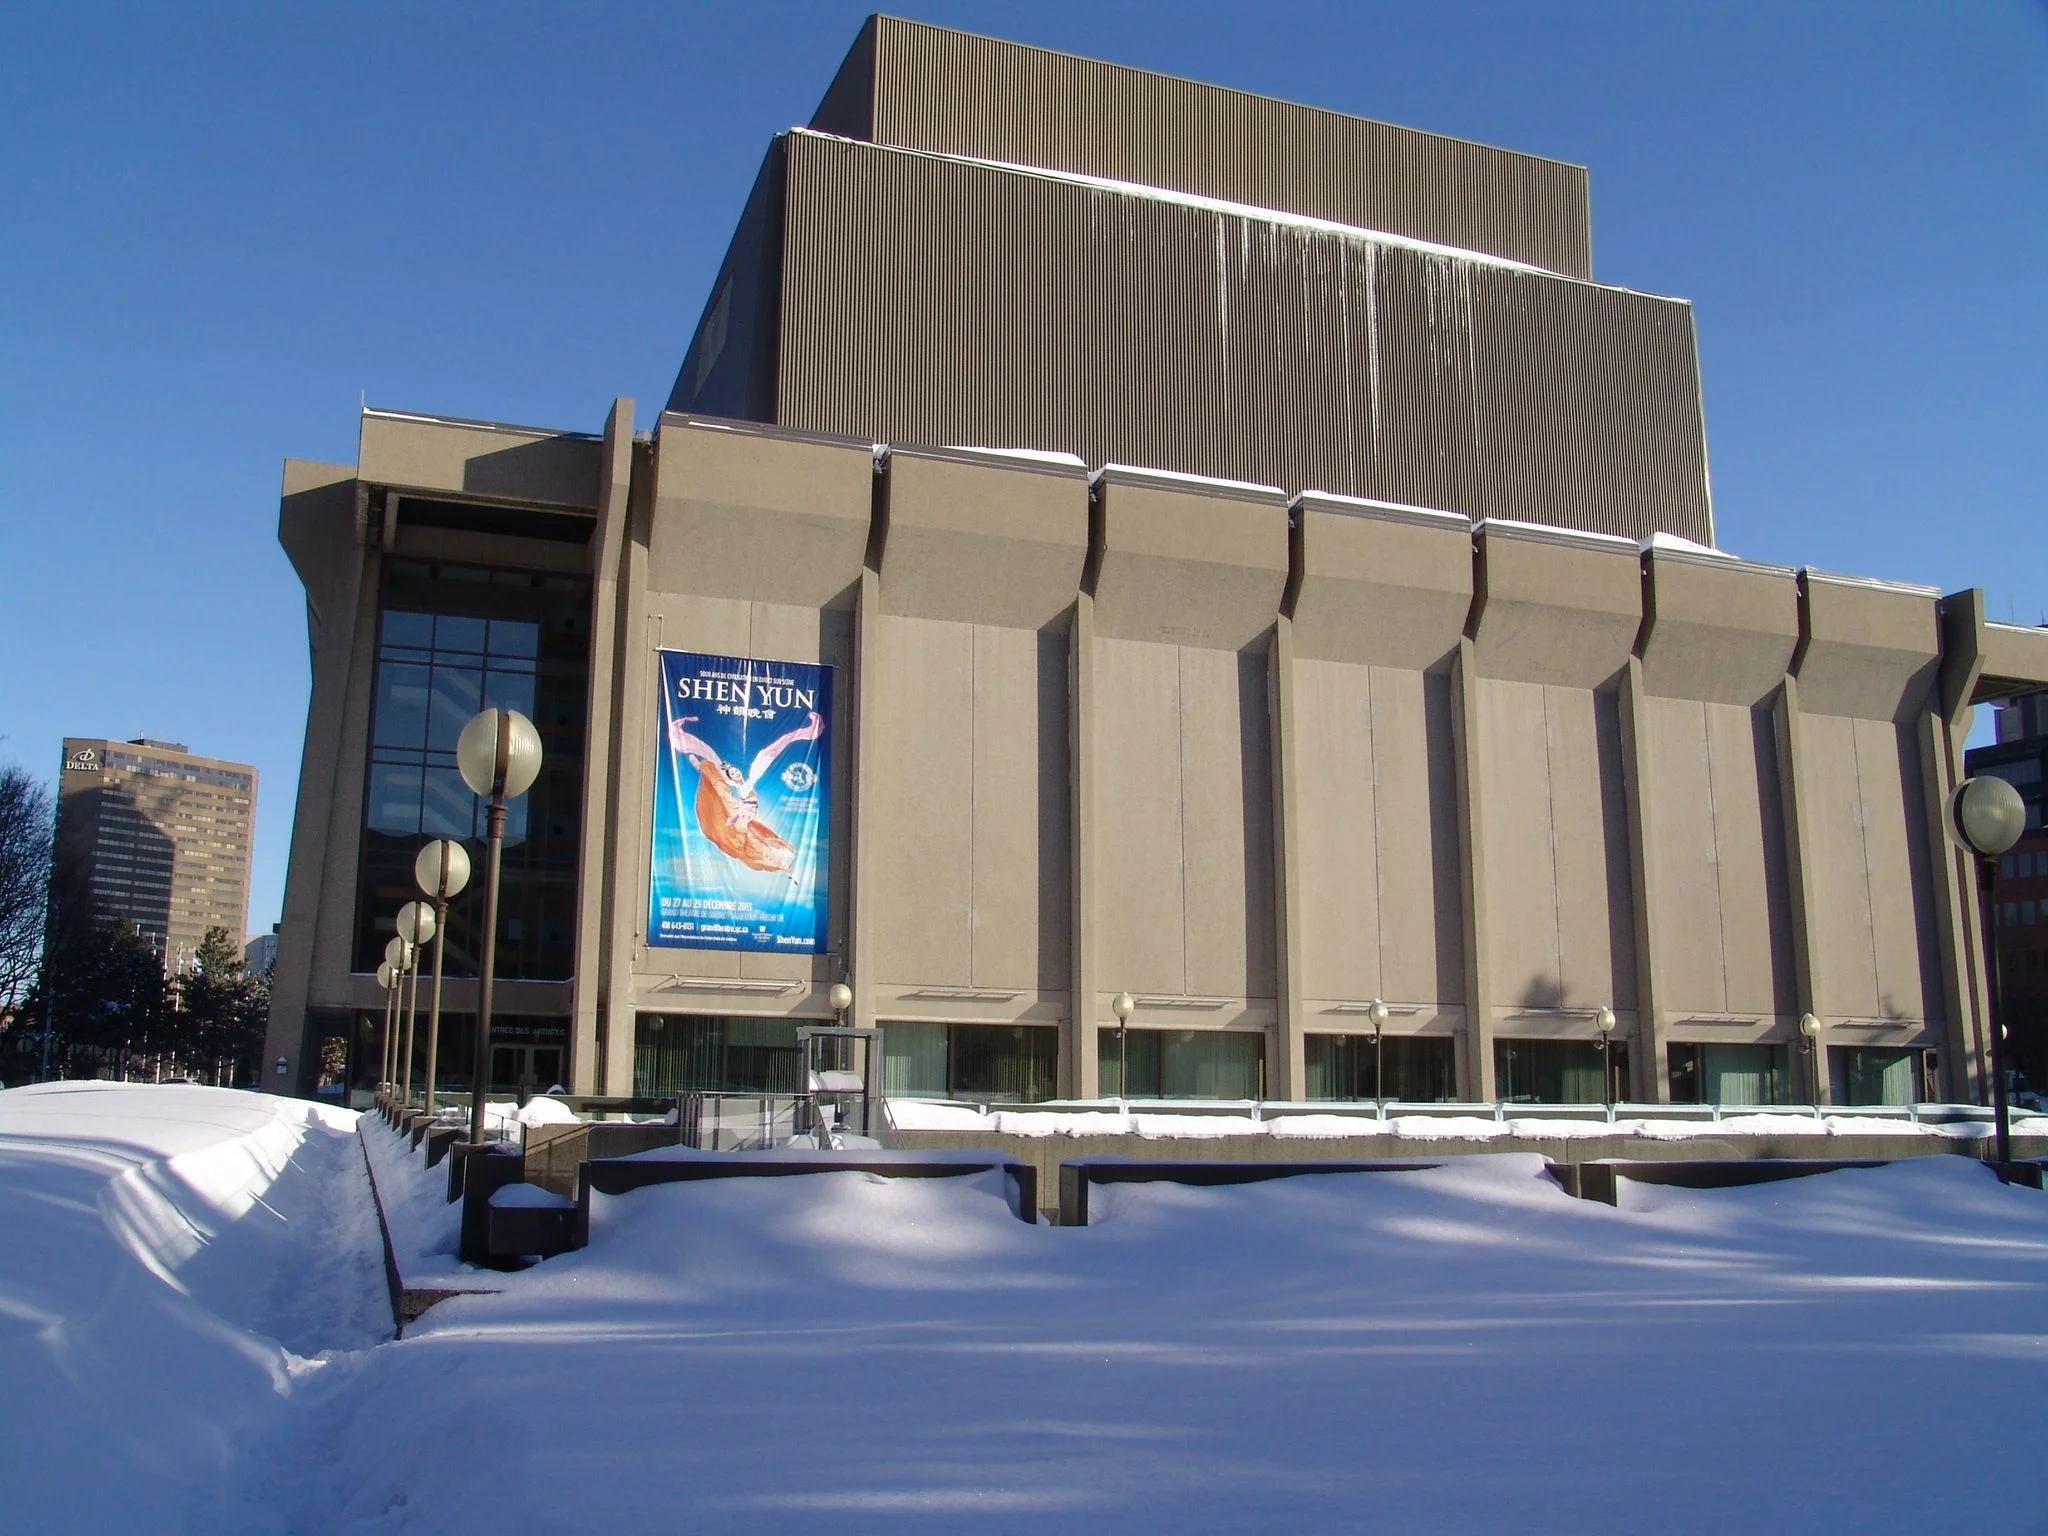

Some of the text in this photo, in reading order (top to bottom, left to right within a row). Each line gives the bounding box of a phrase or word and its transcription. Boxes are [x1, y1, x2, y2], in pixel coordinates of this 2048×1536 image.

[678, 677, 815, 710] SHEN YUN
[66, 761, 100, 770] DELTA
[661, 897, 672, 906] DU
[673, 898, 681, 907] 27
[682, 898, 692, 908] AU
[693, 898, 702, 908] 29
[738, 901, 752, 911] 2013
[776, 935, 816, 946] ShenYun.com
[515, 1026, 530, 1034] DES
